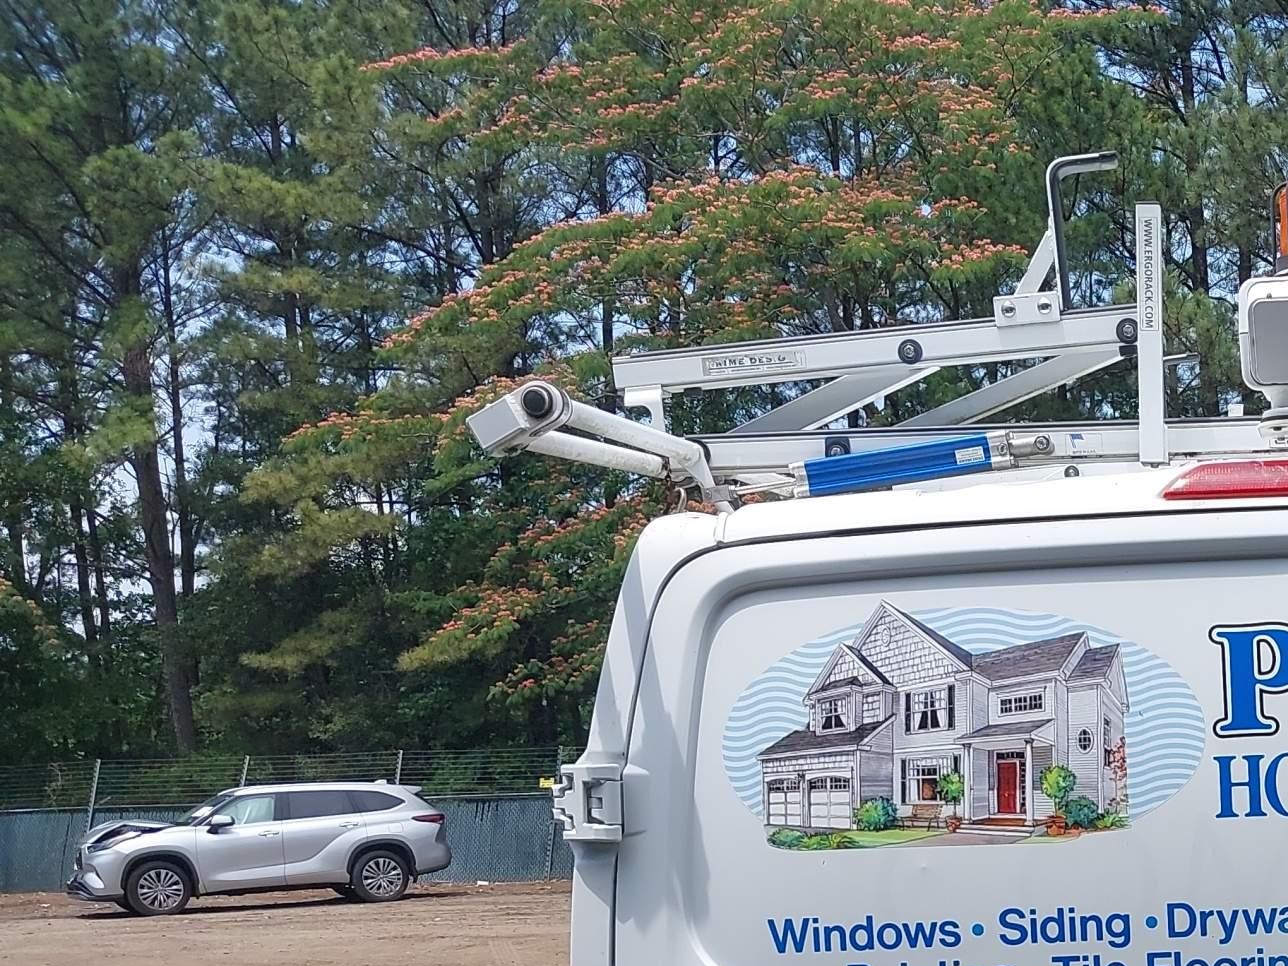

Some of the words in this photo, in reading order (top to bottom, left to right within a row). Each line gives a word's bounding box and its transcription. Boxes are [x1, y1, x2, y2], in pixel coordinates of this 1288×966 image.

[1143, 218, 1154, 329] WWW.ERGORACK.COM
[768, 915, 962, 953] Windows
[998, 907, 1131, 948] Siding
